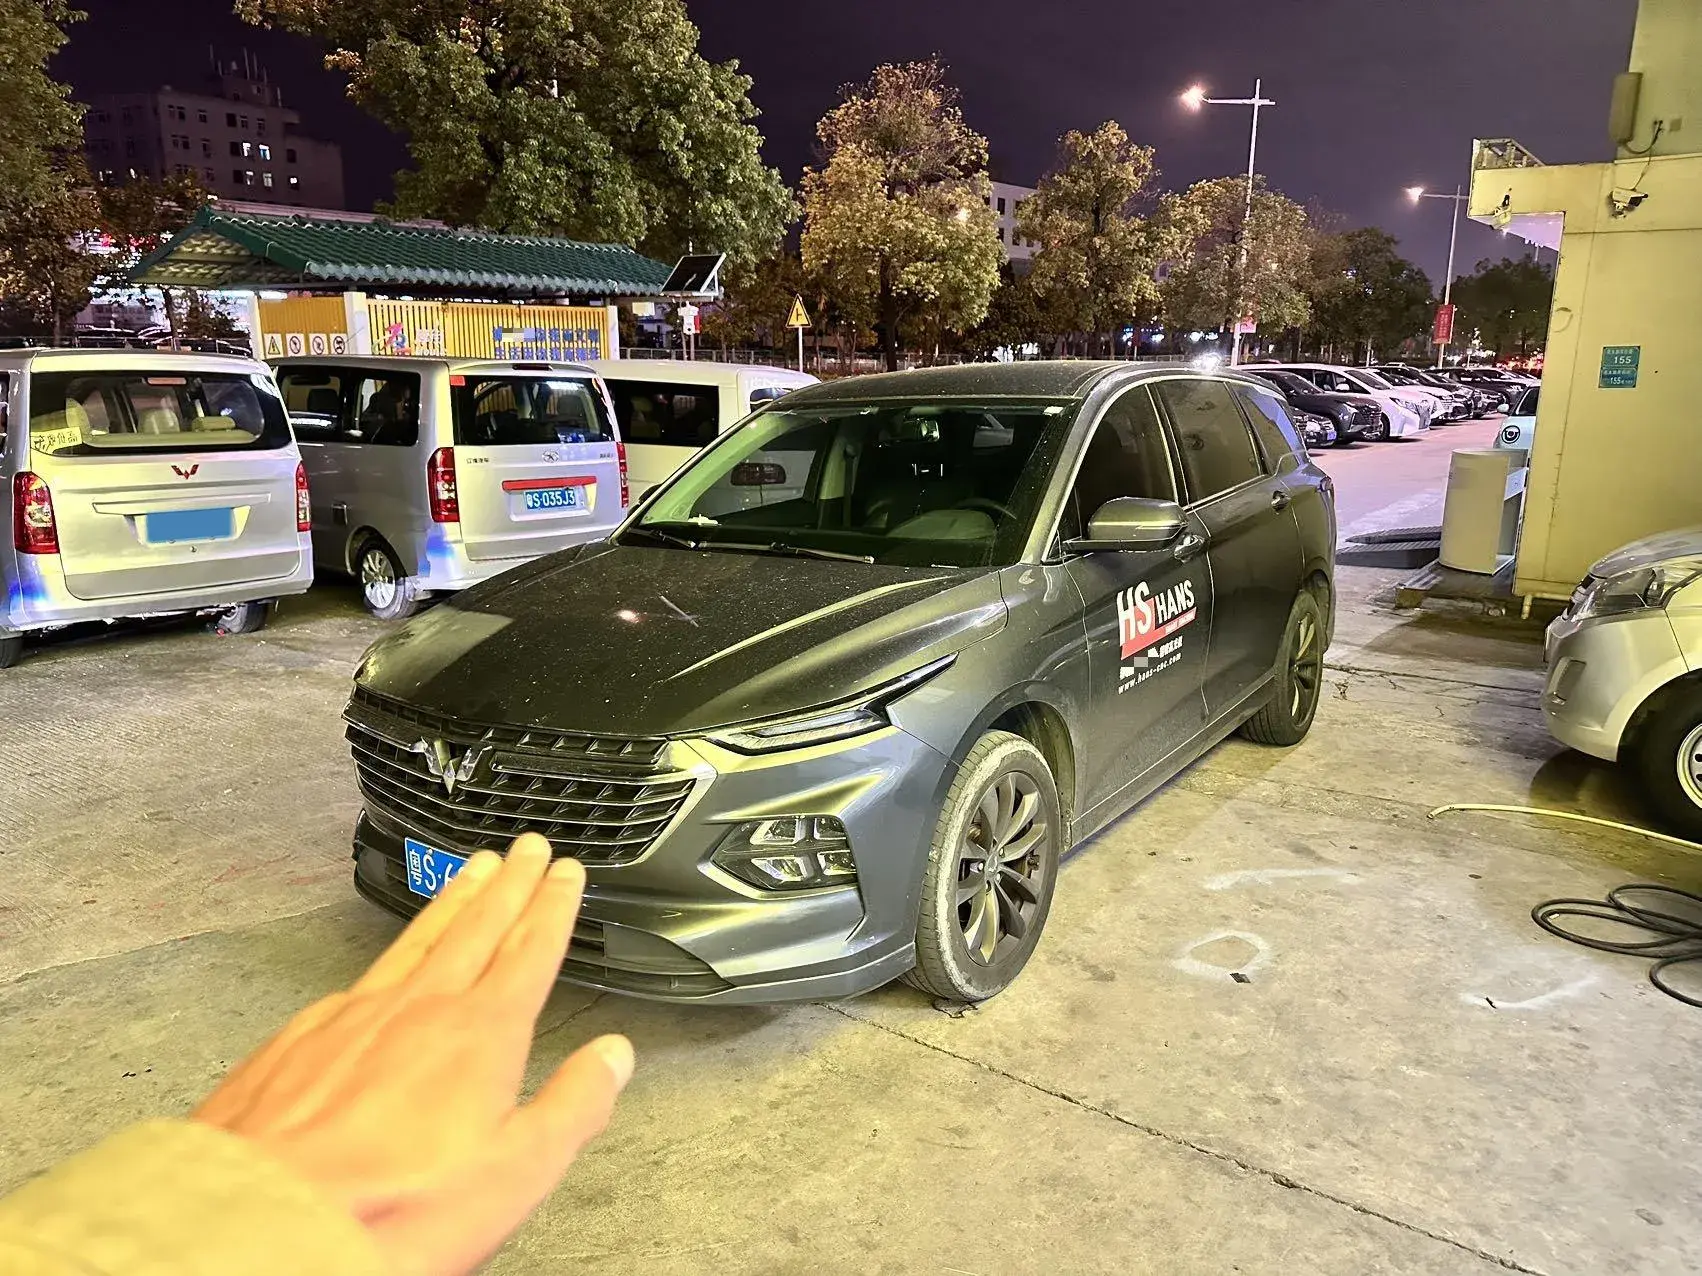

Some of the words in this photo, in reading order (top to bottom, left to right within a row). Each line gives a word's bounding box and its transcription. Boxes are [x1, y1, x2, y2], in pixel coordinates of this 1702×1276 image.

[1614, 355, 1632, 364] 155
[1116, 581, 1152, 647] HS
[1154, 580, 1195, 624] HANS
